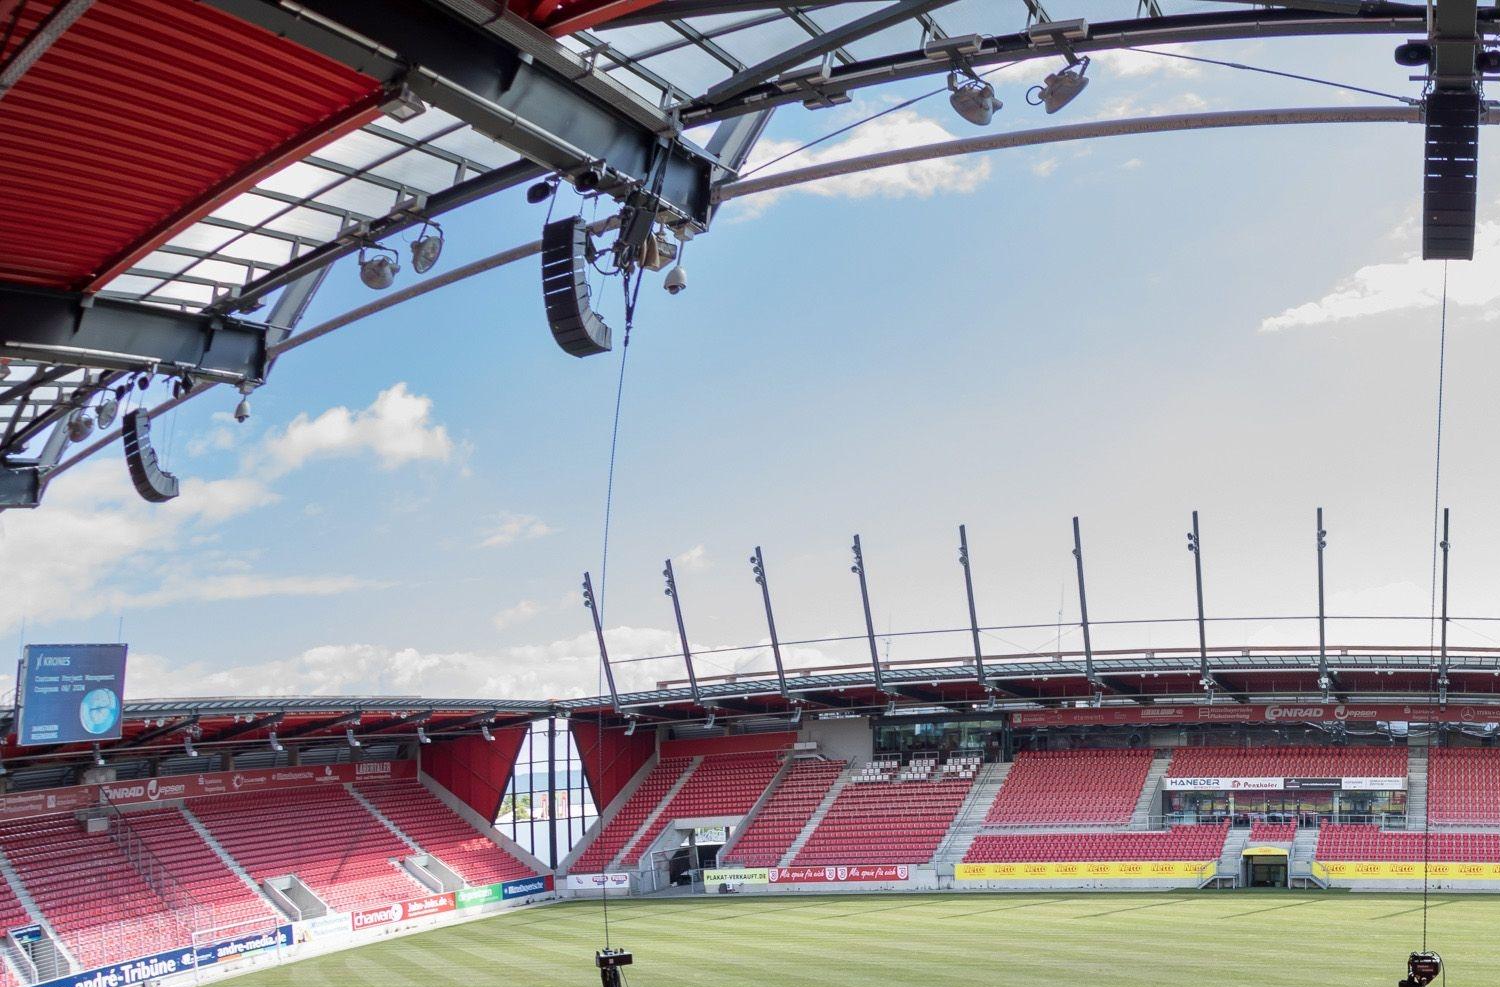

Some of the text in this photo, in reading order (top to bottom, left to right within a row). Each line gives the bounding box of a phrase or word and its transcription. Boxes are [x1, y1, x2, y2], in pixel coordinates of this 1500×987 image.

[1265, 706, 1323, 720] CONRAD
[1335, 706, 1377, 720] Jepsen
[148, 780, 184, 800] Jepsen
[706, 873, 767, 881] PLAKAT-VERKAUFT.DE
[217, 931, 287, 958] andre-media.de
